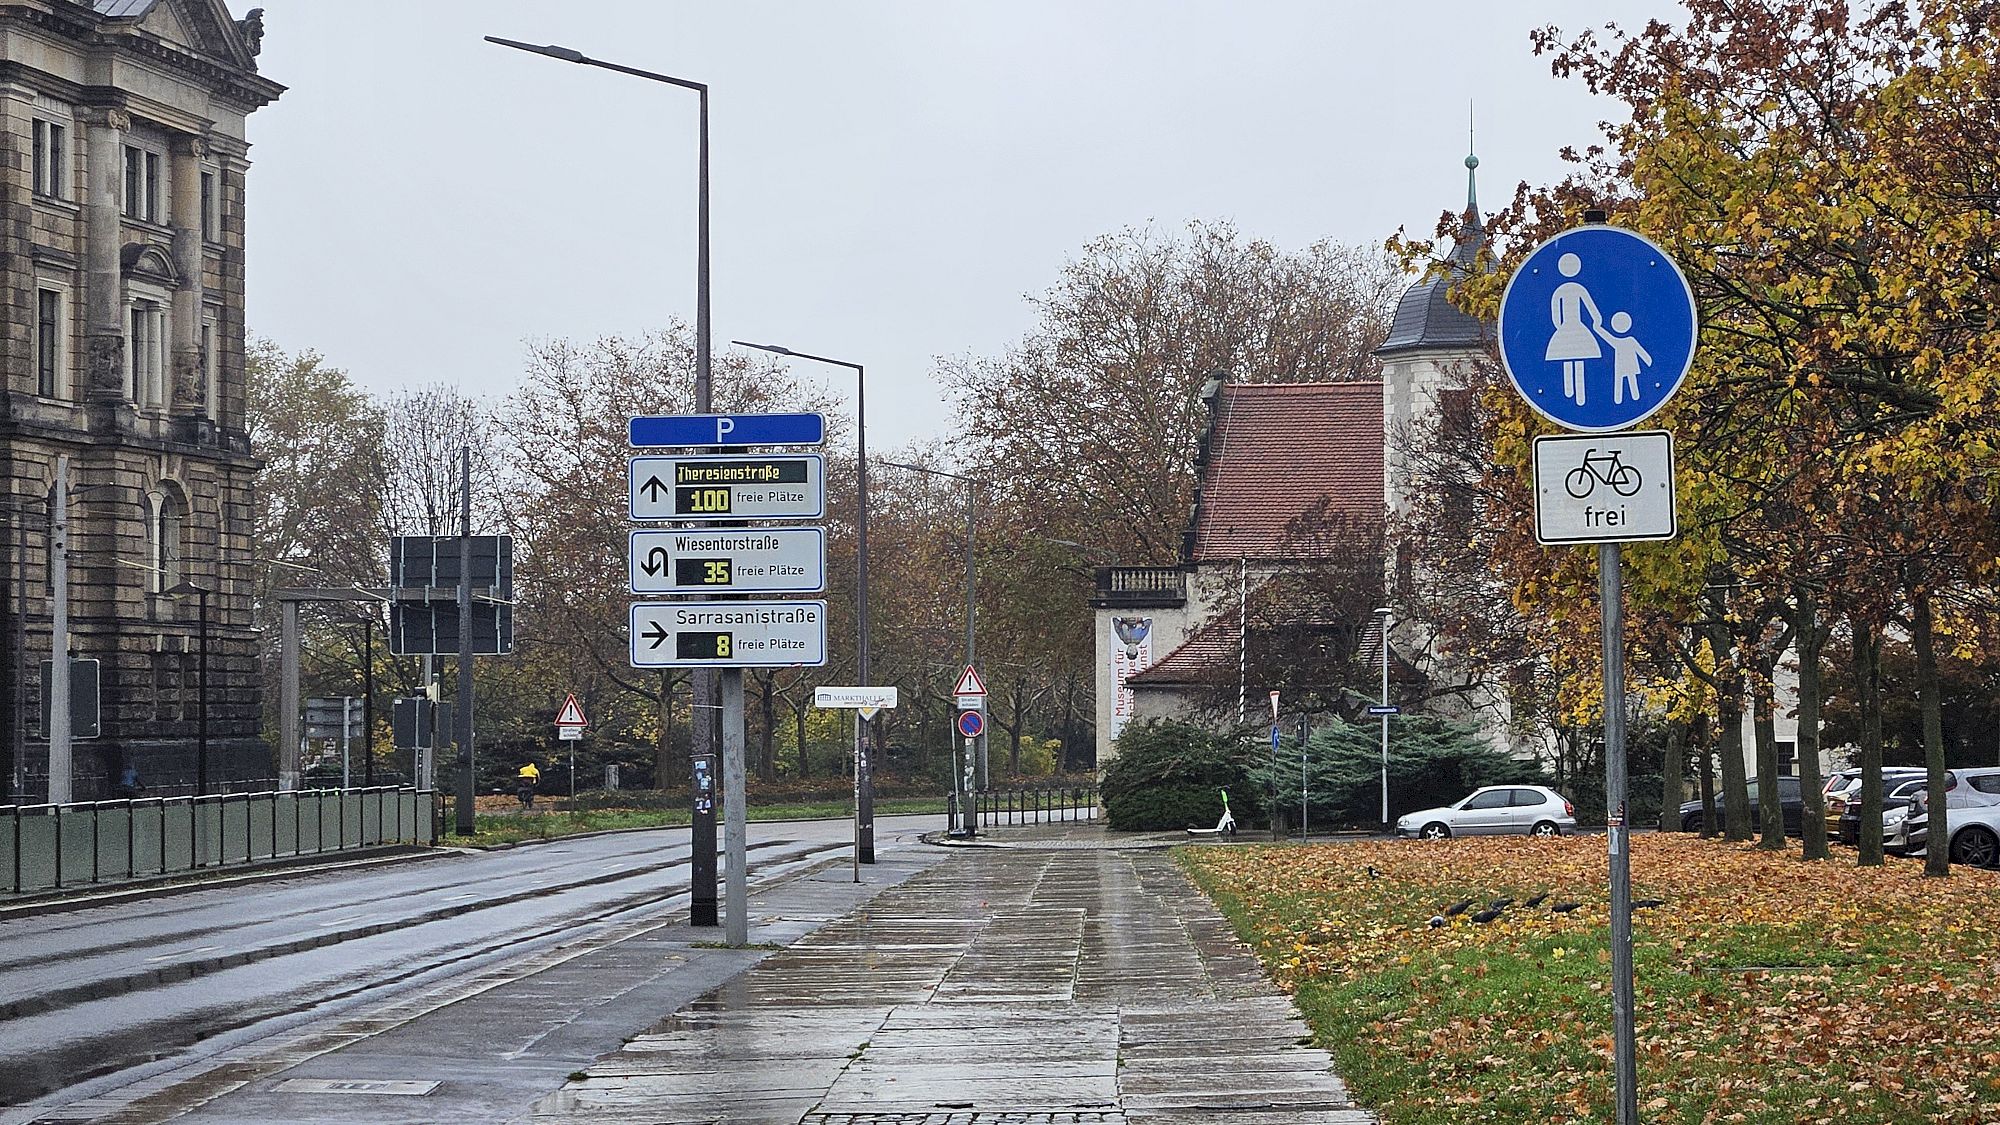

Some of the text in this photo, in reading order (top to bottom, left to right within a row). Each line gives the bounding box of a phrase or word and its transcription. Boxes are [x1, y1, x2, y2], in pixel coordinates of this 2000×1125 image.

[717, 418, 735, 443] P
[678, 465, 780, 482] Theresienstraße
[691, 489, 804, 511] 100 freie Plätze
[1584, 504, 1626, 527] frei
[675, 535, 779, 552] Wiesentorstraße
[703, 561, 805, 583] 35 freie Plätze
[676, 608, 816, 625] Sarrasanistraße
[716, 635, 805, 656] 8 freie Plätze
[1139, 644, 1148, 671] unst
[1114, 648, 1125, 717] Museum für
